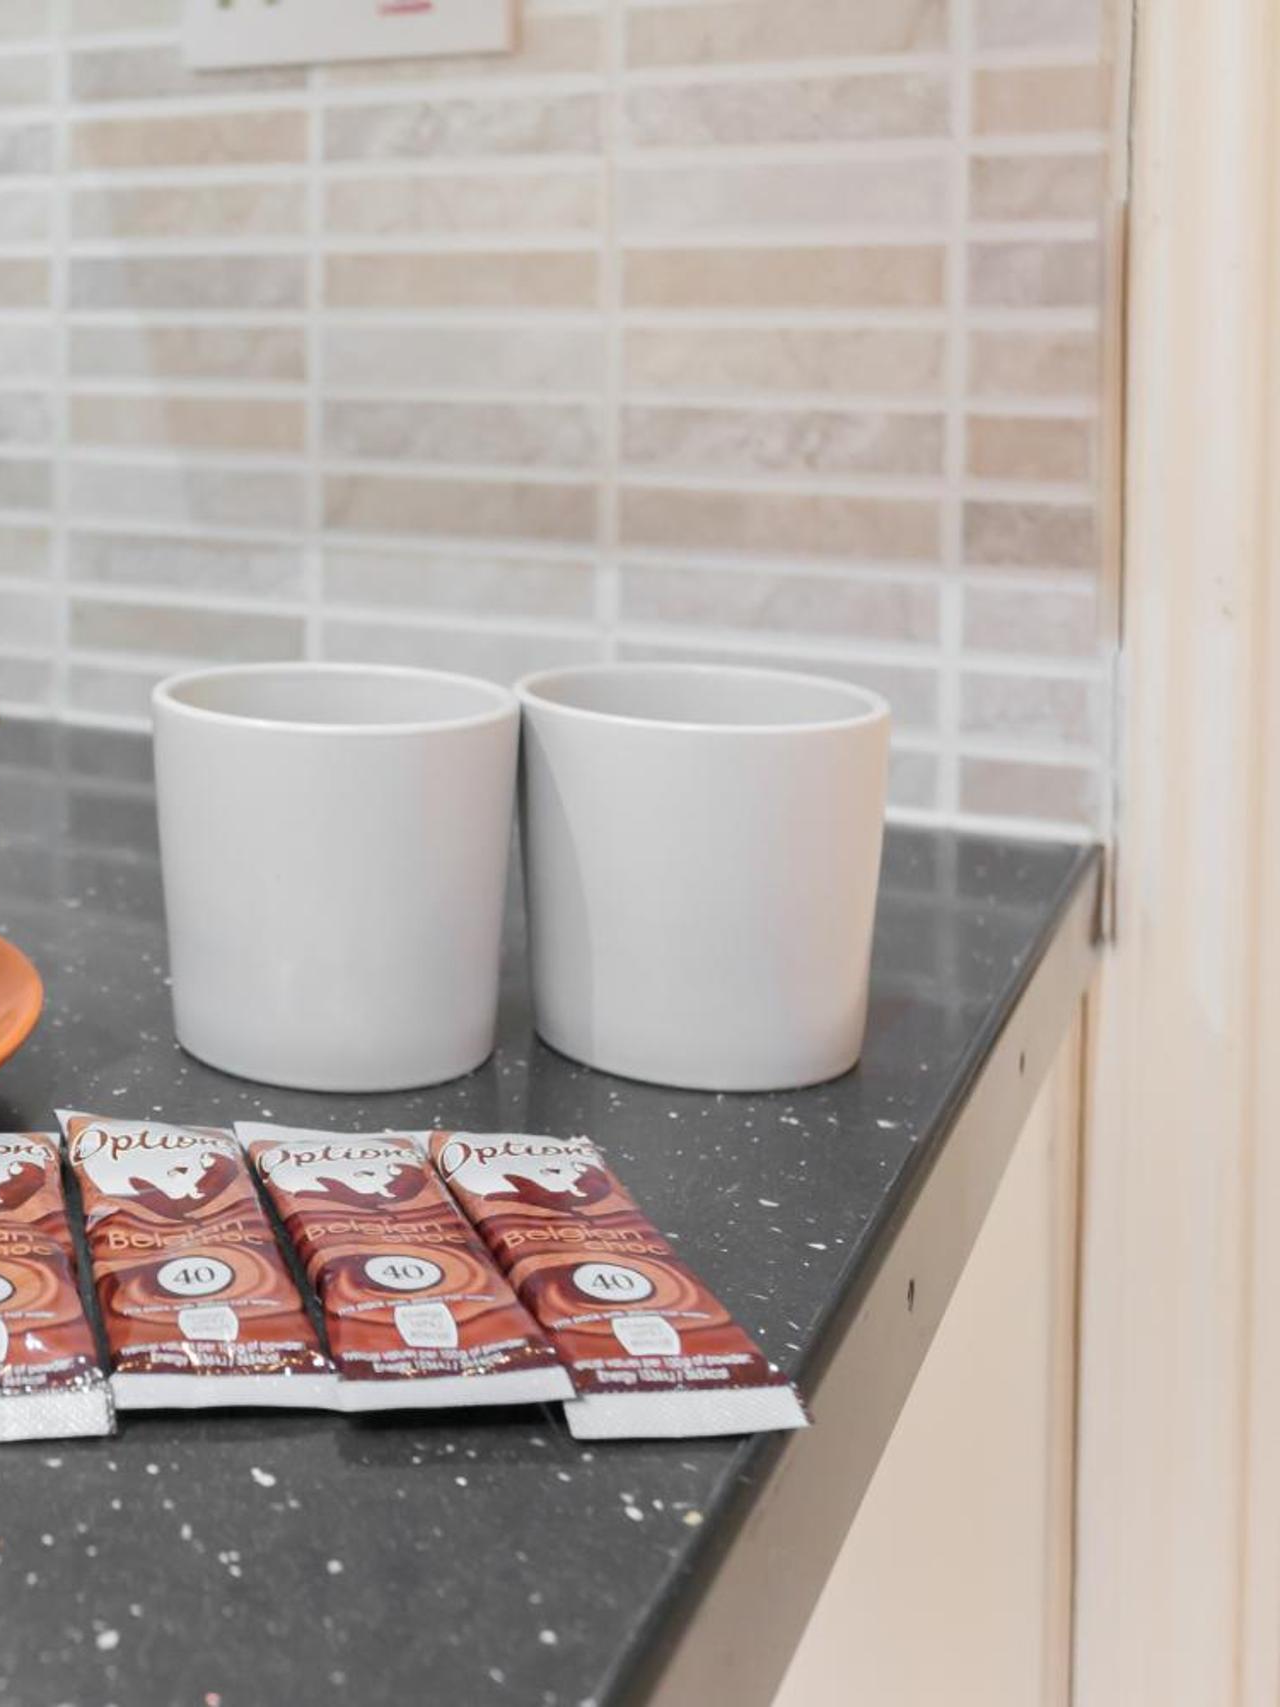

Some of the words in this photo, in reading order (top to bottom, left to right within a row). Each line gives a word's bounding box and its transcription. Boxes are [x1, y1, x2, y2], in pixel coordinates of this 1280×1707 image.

[72, 1128, 232, 1164] Option
[438, 1140, 596, 1183] Option
[304, 1216, 442, 1242] Belgian
[502, 1218, 644, 1250] Belgian
[583, 1237, 669, 1256] choc
[172, 1265, 216, 1284] 40
[381, 1263, 425, 1280] 40
[591, 1273, 635, 1291] 40
